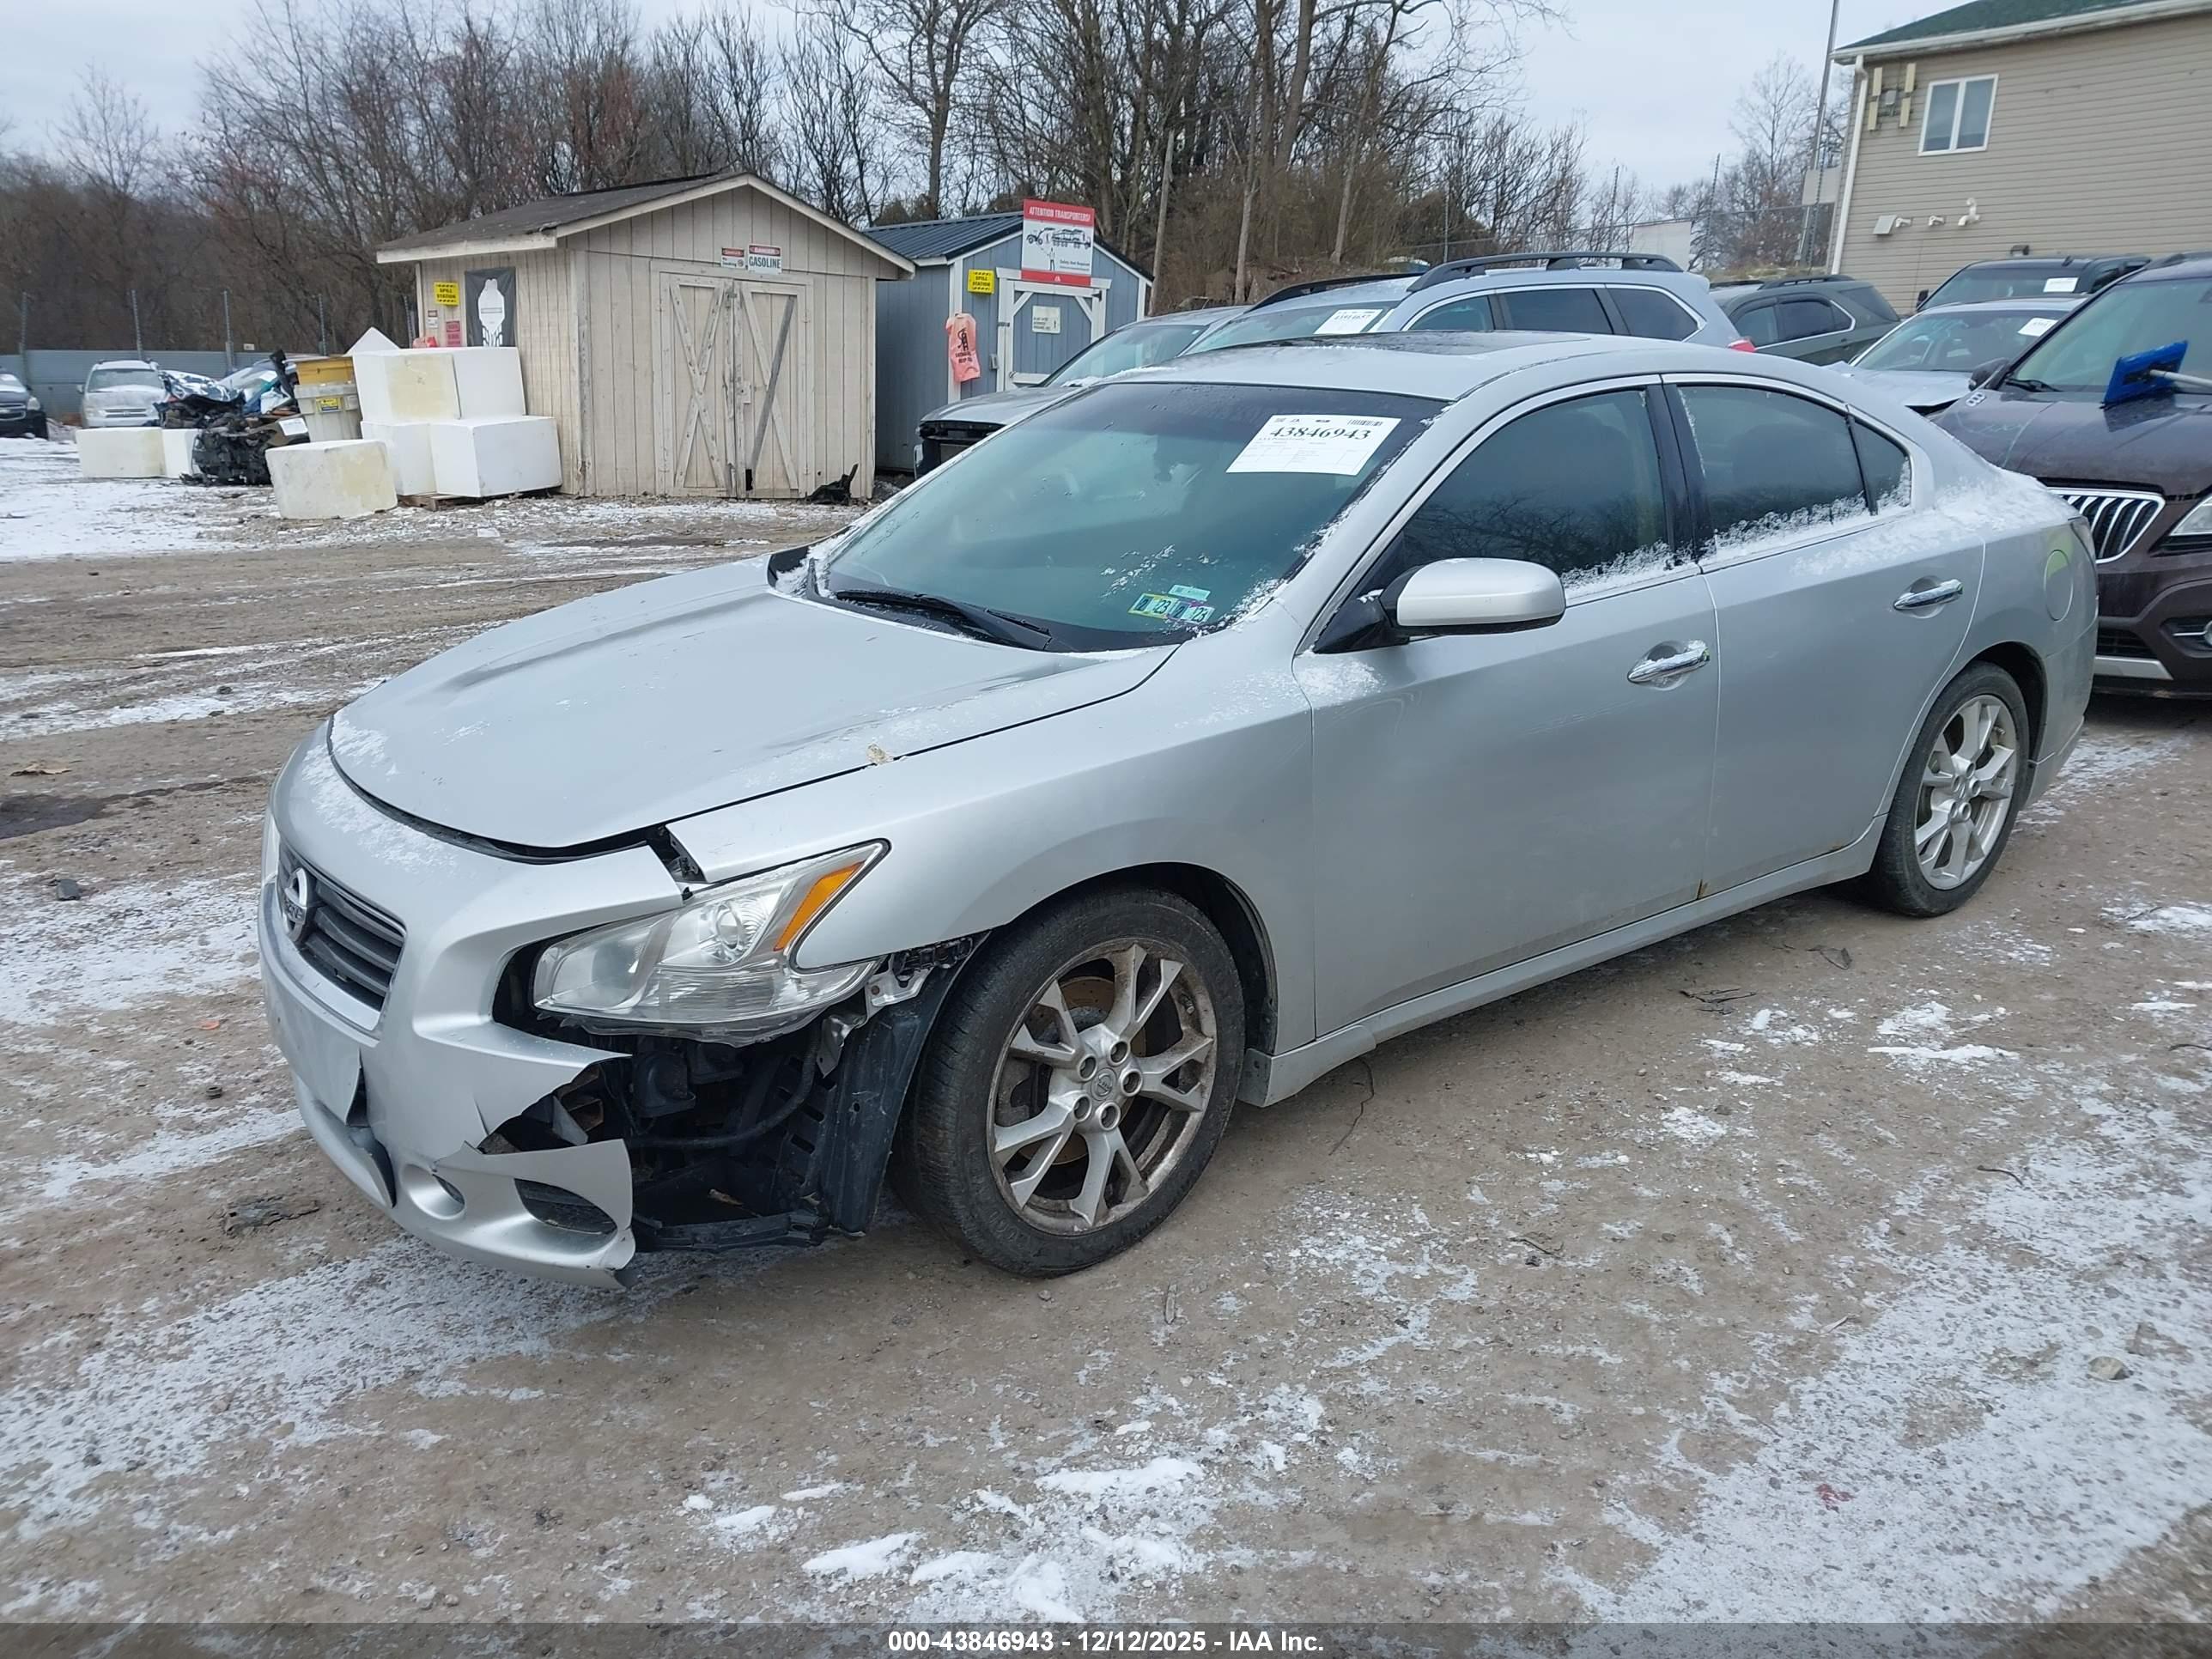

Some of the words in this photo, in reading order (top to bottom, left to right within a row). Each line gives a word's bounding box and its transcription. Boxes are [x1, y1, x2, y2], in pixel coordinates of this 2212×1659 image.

[1029, 206, 1054, 217] ATTENTION
[749, 256, 781, 269] GASOLINE
[1270, 426, 1371, 440] 43846943
